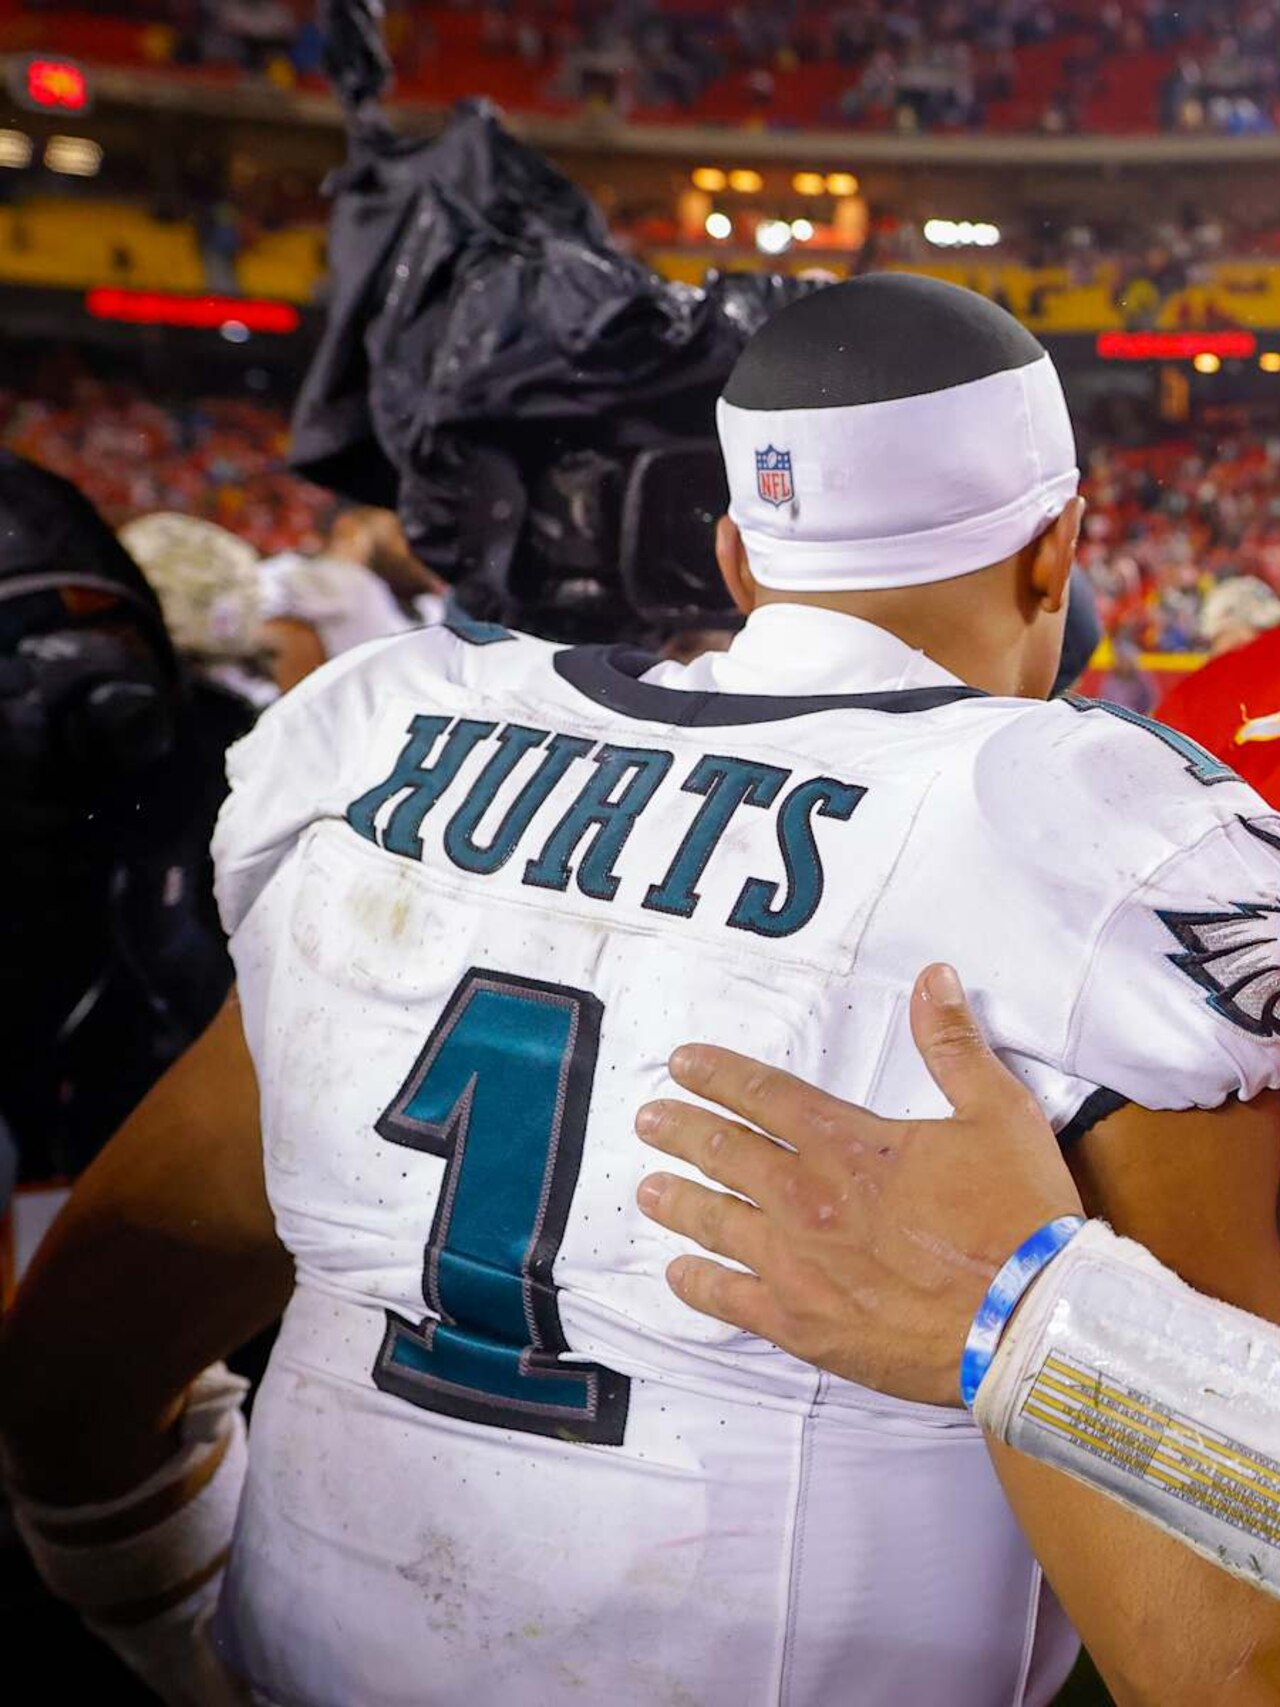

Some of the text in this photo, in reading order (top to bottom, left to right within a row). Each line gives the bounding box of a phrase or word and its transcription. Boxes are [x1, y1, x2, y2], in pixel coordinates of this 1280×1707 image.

[760, 472, 791, 501] NFL
[345, 714, 869, 938] HURTS
[372, 965, 632, 1447] 1
